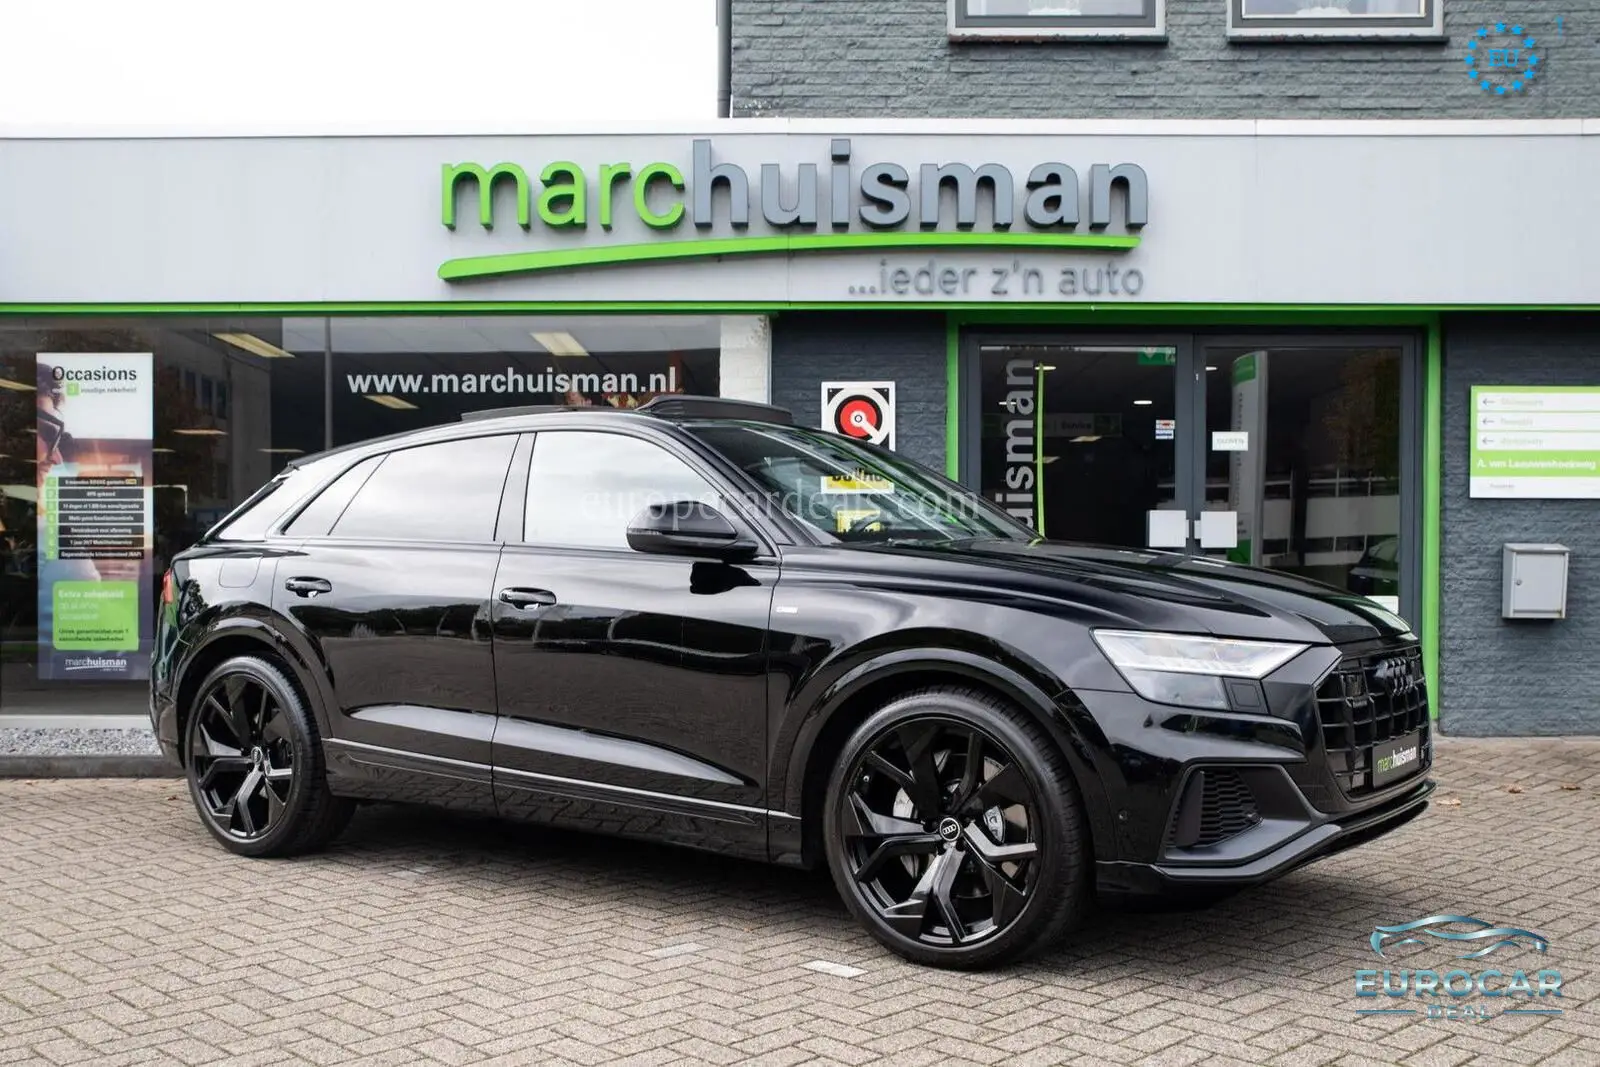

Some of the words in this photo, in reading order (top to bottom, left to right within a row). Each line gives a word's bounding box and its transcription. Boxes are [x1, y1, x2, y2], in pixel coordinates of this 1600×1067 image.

[441, 138, 1149, 232] marchuisman
[991, 261, 1045, 296] z'n
[1057, 264, 1145, 296] auto
[52, 365, 137, 381] Occasions
[347, 366, 677, 393] www.marchuisman.nl
[65, 656, 128, 667] marchuisman
